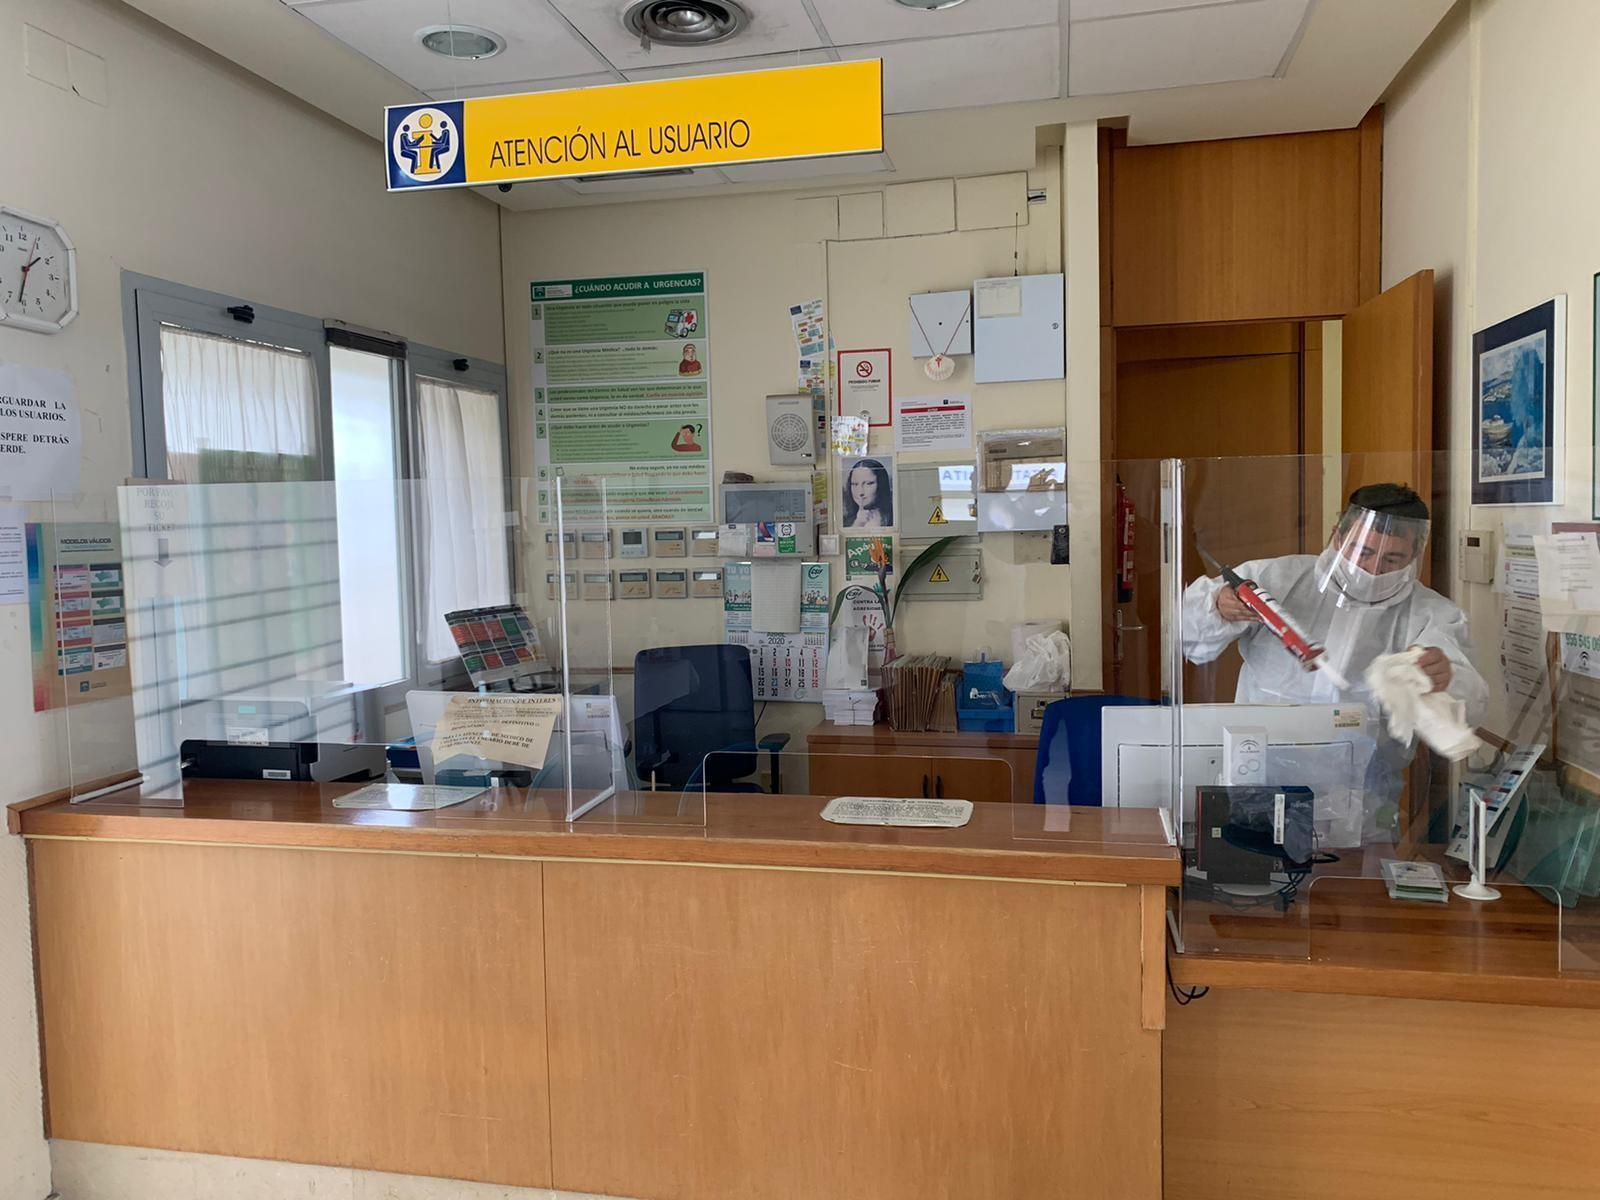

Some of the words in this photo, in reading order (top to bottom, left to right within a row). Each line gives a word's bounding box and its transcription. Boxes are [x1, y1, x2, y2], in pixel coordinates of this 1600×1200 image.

[490, 125, 607, 169] ATENCIÓN
[614, 130, 641, 156] AL
[649, 118, 751, 154] USUARIO
[575, 282, 612, 294] ¿CUÁNDO
[613, 282, 642, 291] ACUDIR
[653, 278, 701, 289] URGENCIAS?
[55, 401, 67, 410] LA
[0, 407, 17, 417] LOS
[19, 409, 66, 421] USUARIOS.
[0, 432, 29, 442] SPERE
[33, 433, 70, 444] DETRÁS
[0, 444, 26, 454] ERDE.
